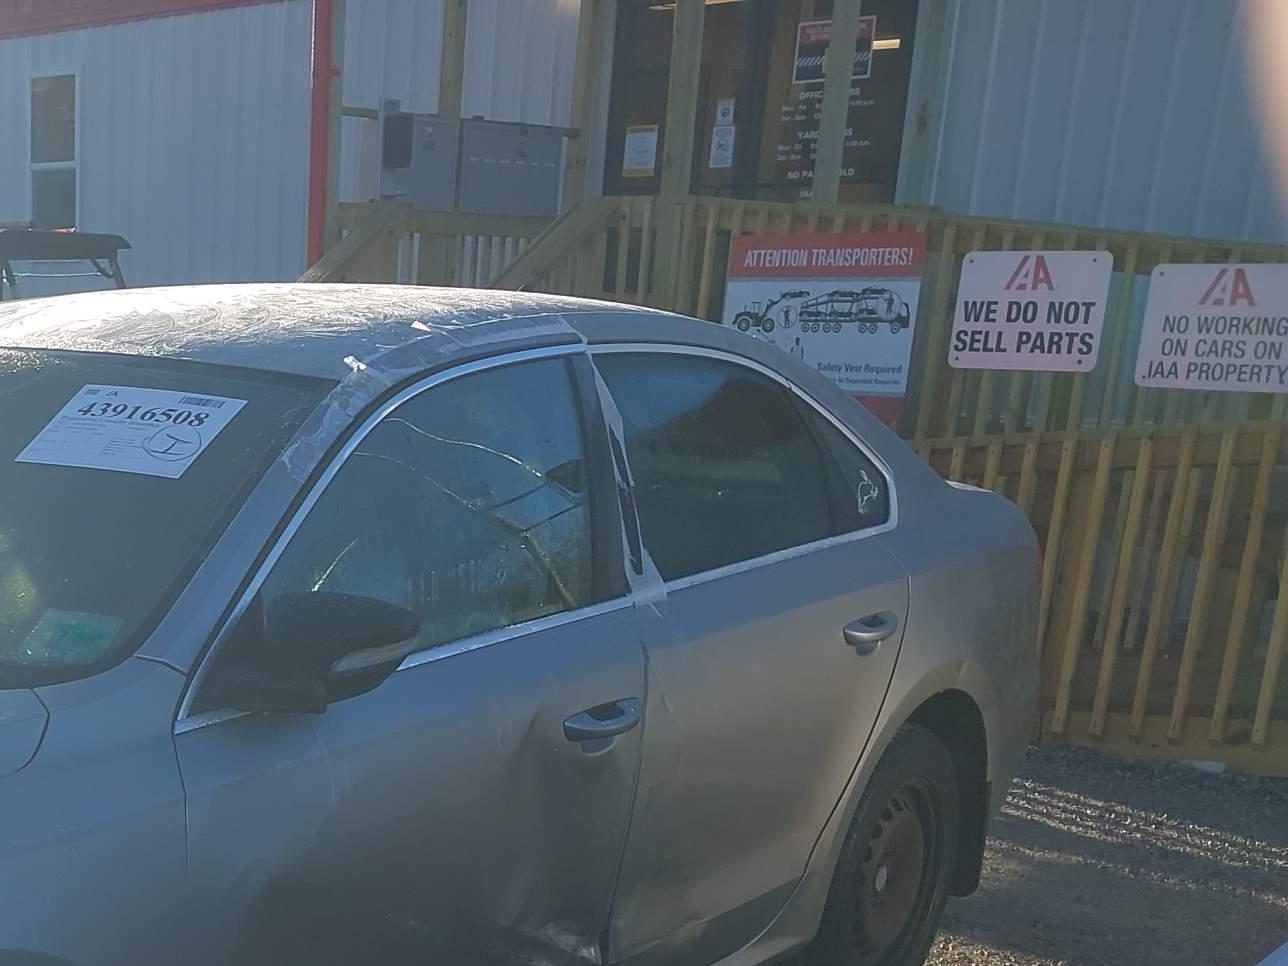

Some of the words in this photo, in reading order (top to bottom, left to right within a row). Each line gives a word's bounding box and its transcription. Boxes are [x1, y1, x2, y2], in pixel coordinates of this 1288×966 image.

[744, 249, 808, 267] ATTENTION
[811, 248, 913, 267] TRANSPORTERS!
[964, 300, 999, 323] WE
[1005, 300, 1039, 324] DO
[1046, 301, 1096, 325] NOT
[1162, 315, 1189, 334] NO
[1197, 315, 1288, 336] WORKING
[953, 329, 1007, 353] SELL
[1015, 331, 1094, 355] PARTS
[1161, 338, 1188, 357] ON
[1194, 338, 1247, 359] CARS
[1253, 340, 1283, 360] ON
[1186, 361, 1288, 384] PROPERTY
[77, 402, 210, 427] 43916508
